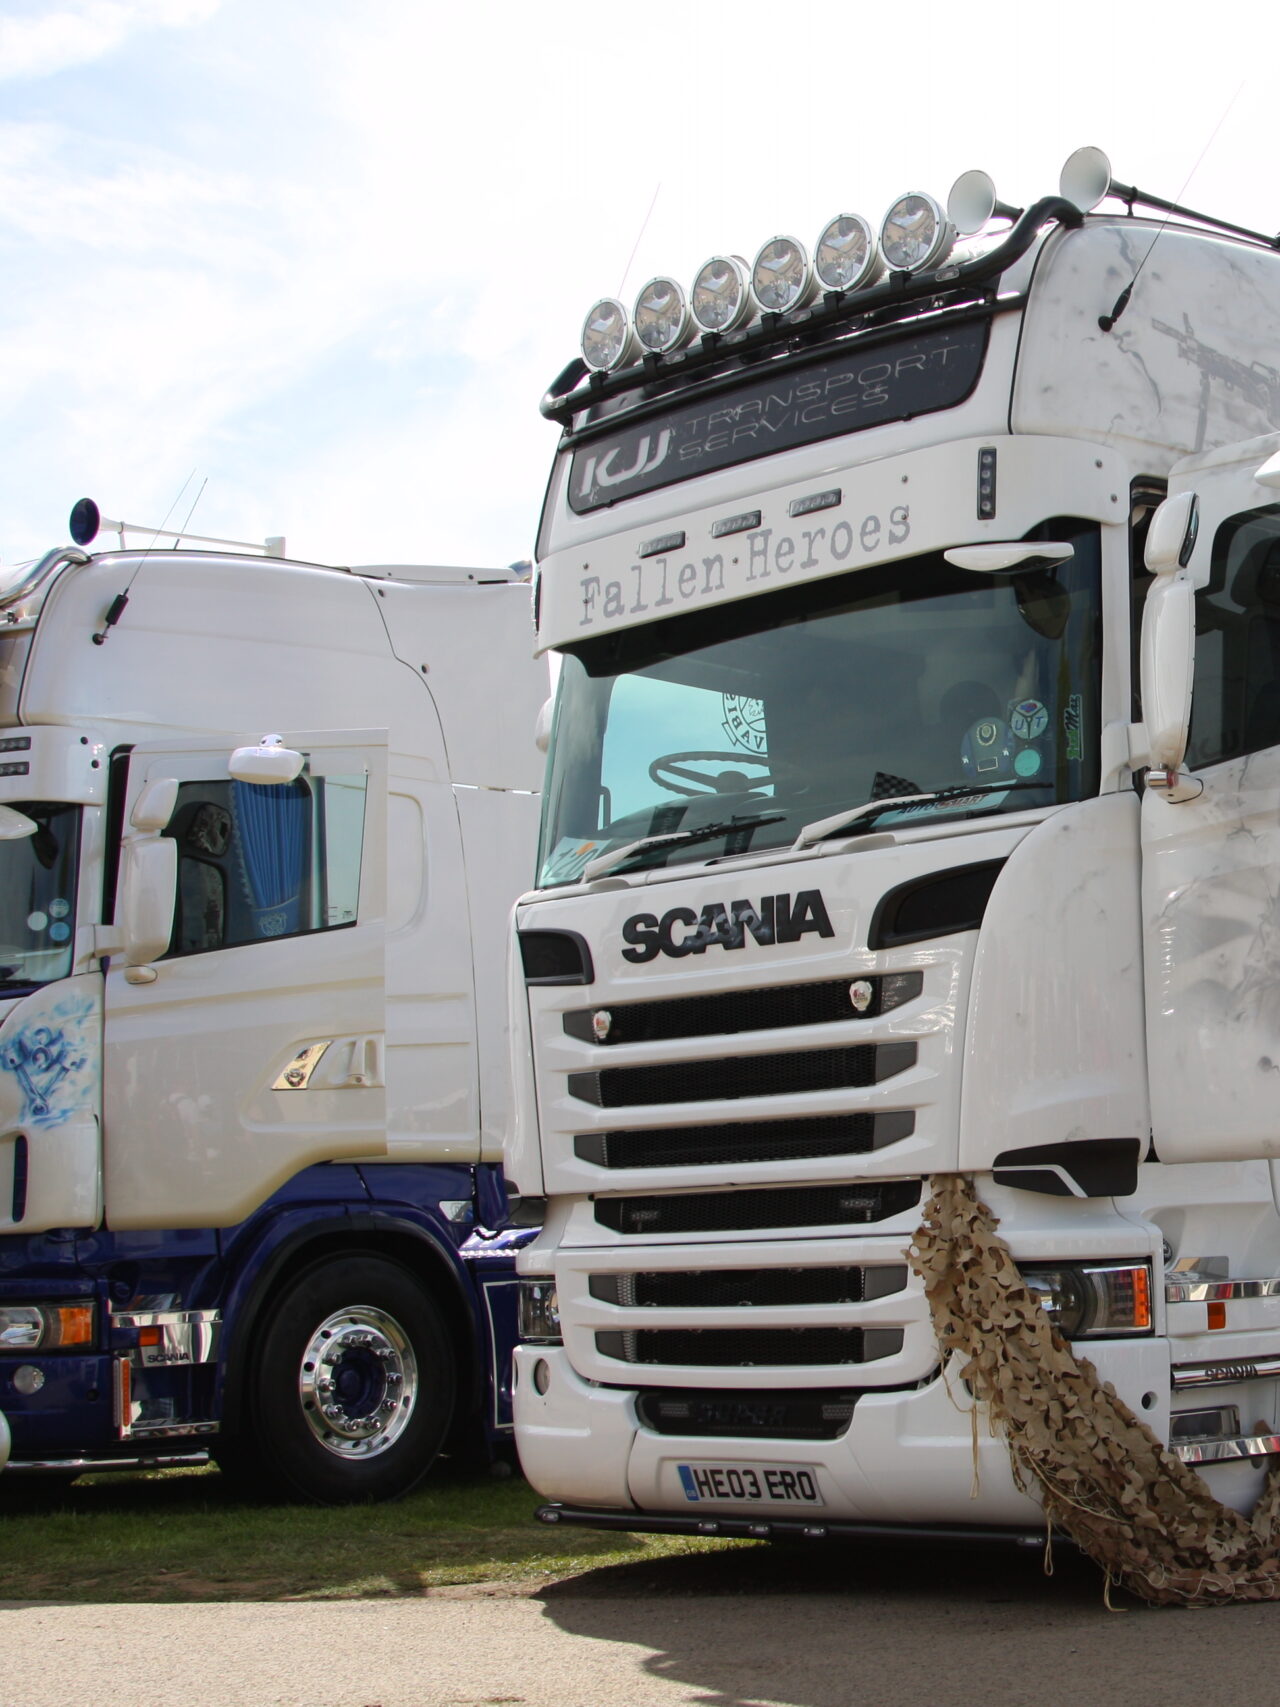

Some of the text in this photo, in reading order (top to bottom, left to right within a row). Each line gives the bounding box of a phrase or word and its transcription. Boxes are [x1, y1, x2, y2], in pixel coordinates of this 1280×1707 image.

[679, 385, 889, 461] SERVICES
[685, 345, 960, 434] TRANSPORT
[579, 504, 911, 626] Fallen Heroes
[621, 889, 836, 963] SCANIA
[148, 1352, 190, 1363] SCANIA
[693, 1469, 817, 1500] HE03 ERO
